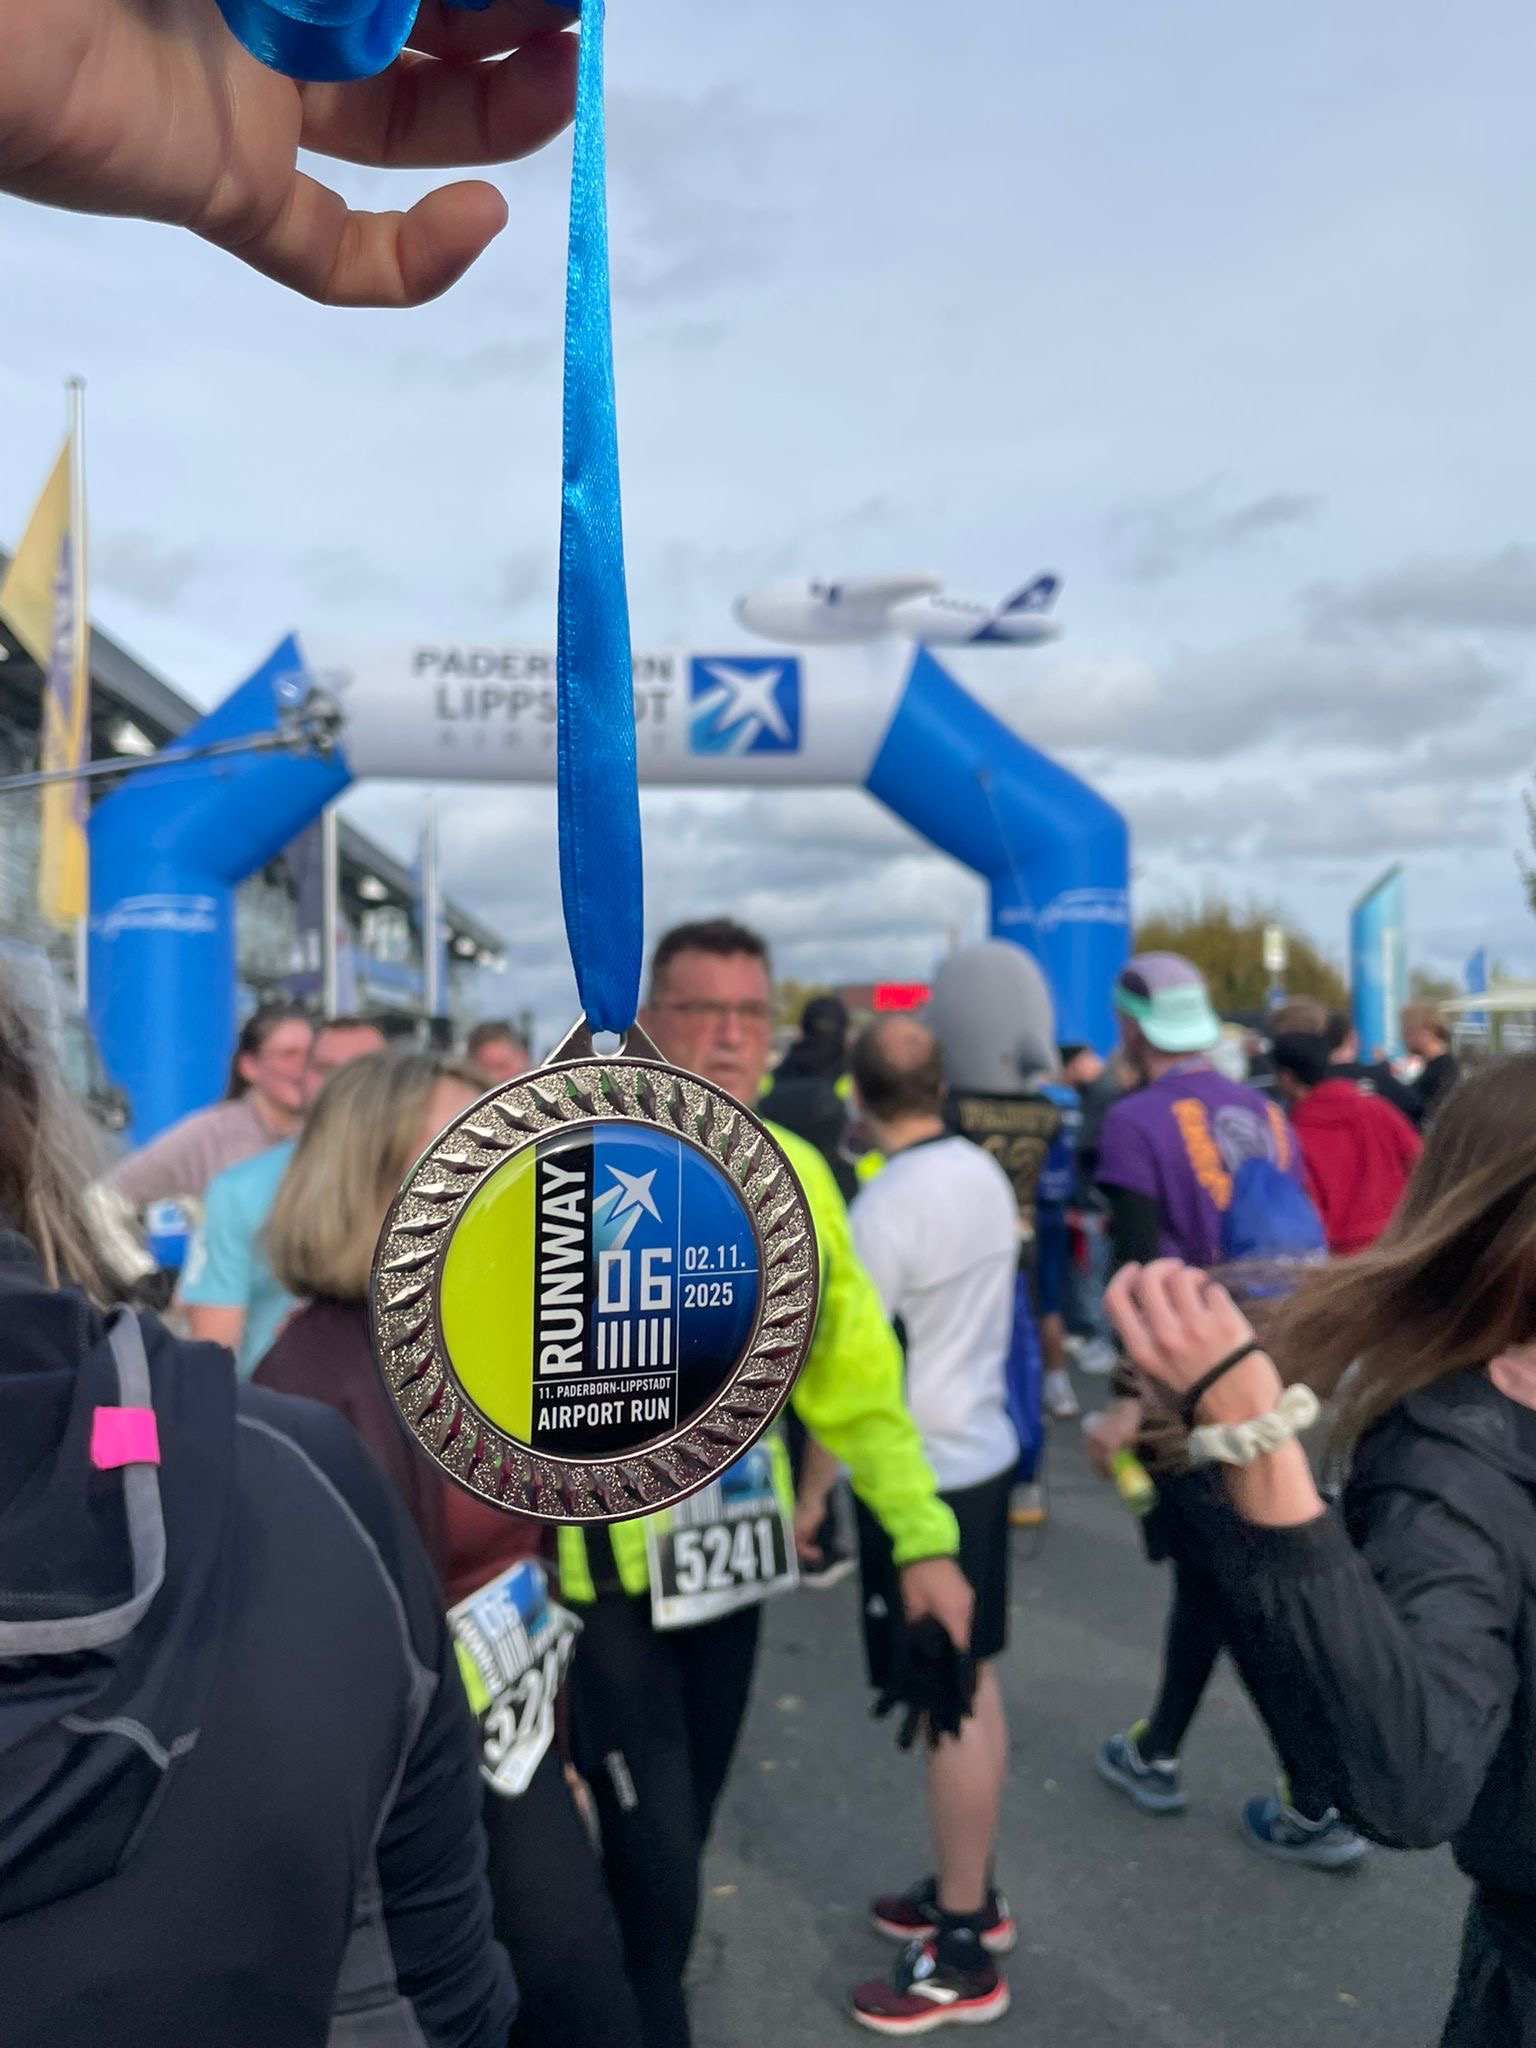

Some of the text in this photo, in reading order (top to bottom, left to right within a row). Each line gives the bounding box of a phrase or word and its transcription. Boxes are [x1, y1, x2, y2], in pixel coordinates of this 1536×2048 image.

[539, 1161, 586, 1374] RUNWAY
[685, 1244, 746, 1271] 02.11.
[598, 1247, 672, 1314] 06
[684, 1282, 733, 1308] 2025
[539, 1377, 671, 1400] 11. PADERBORN-LIPPSTADT
[538, 1396, 670, 1431] AIRPORT RUN
[673, 1516, 777, 1594] 5241
